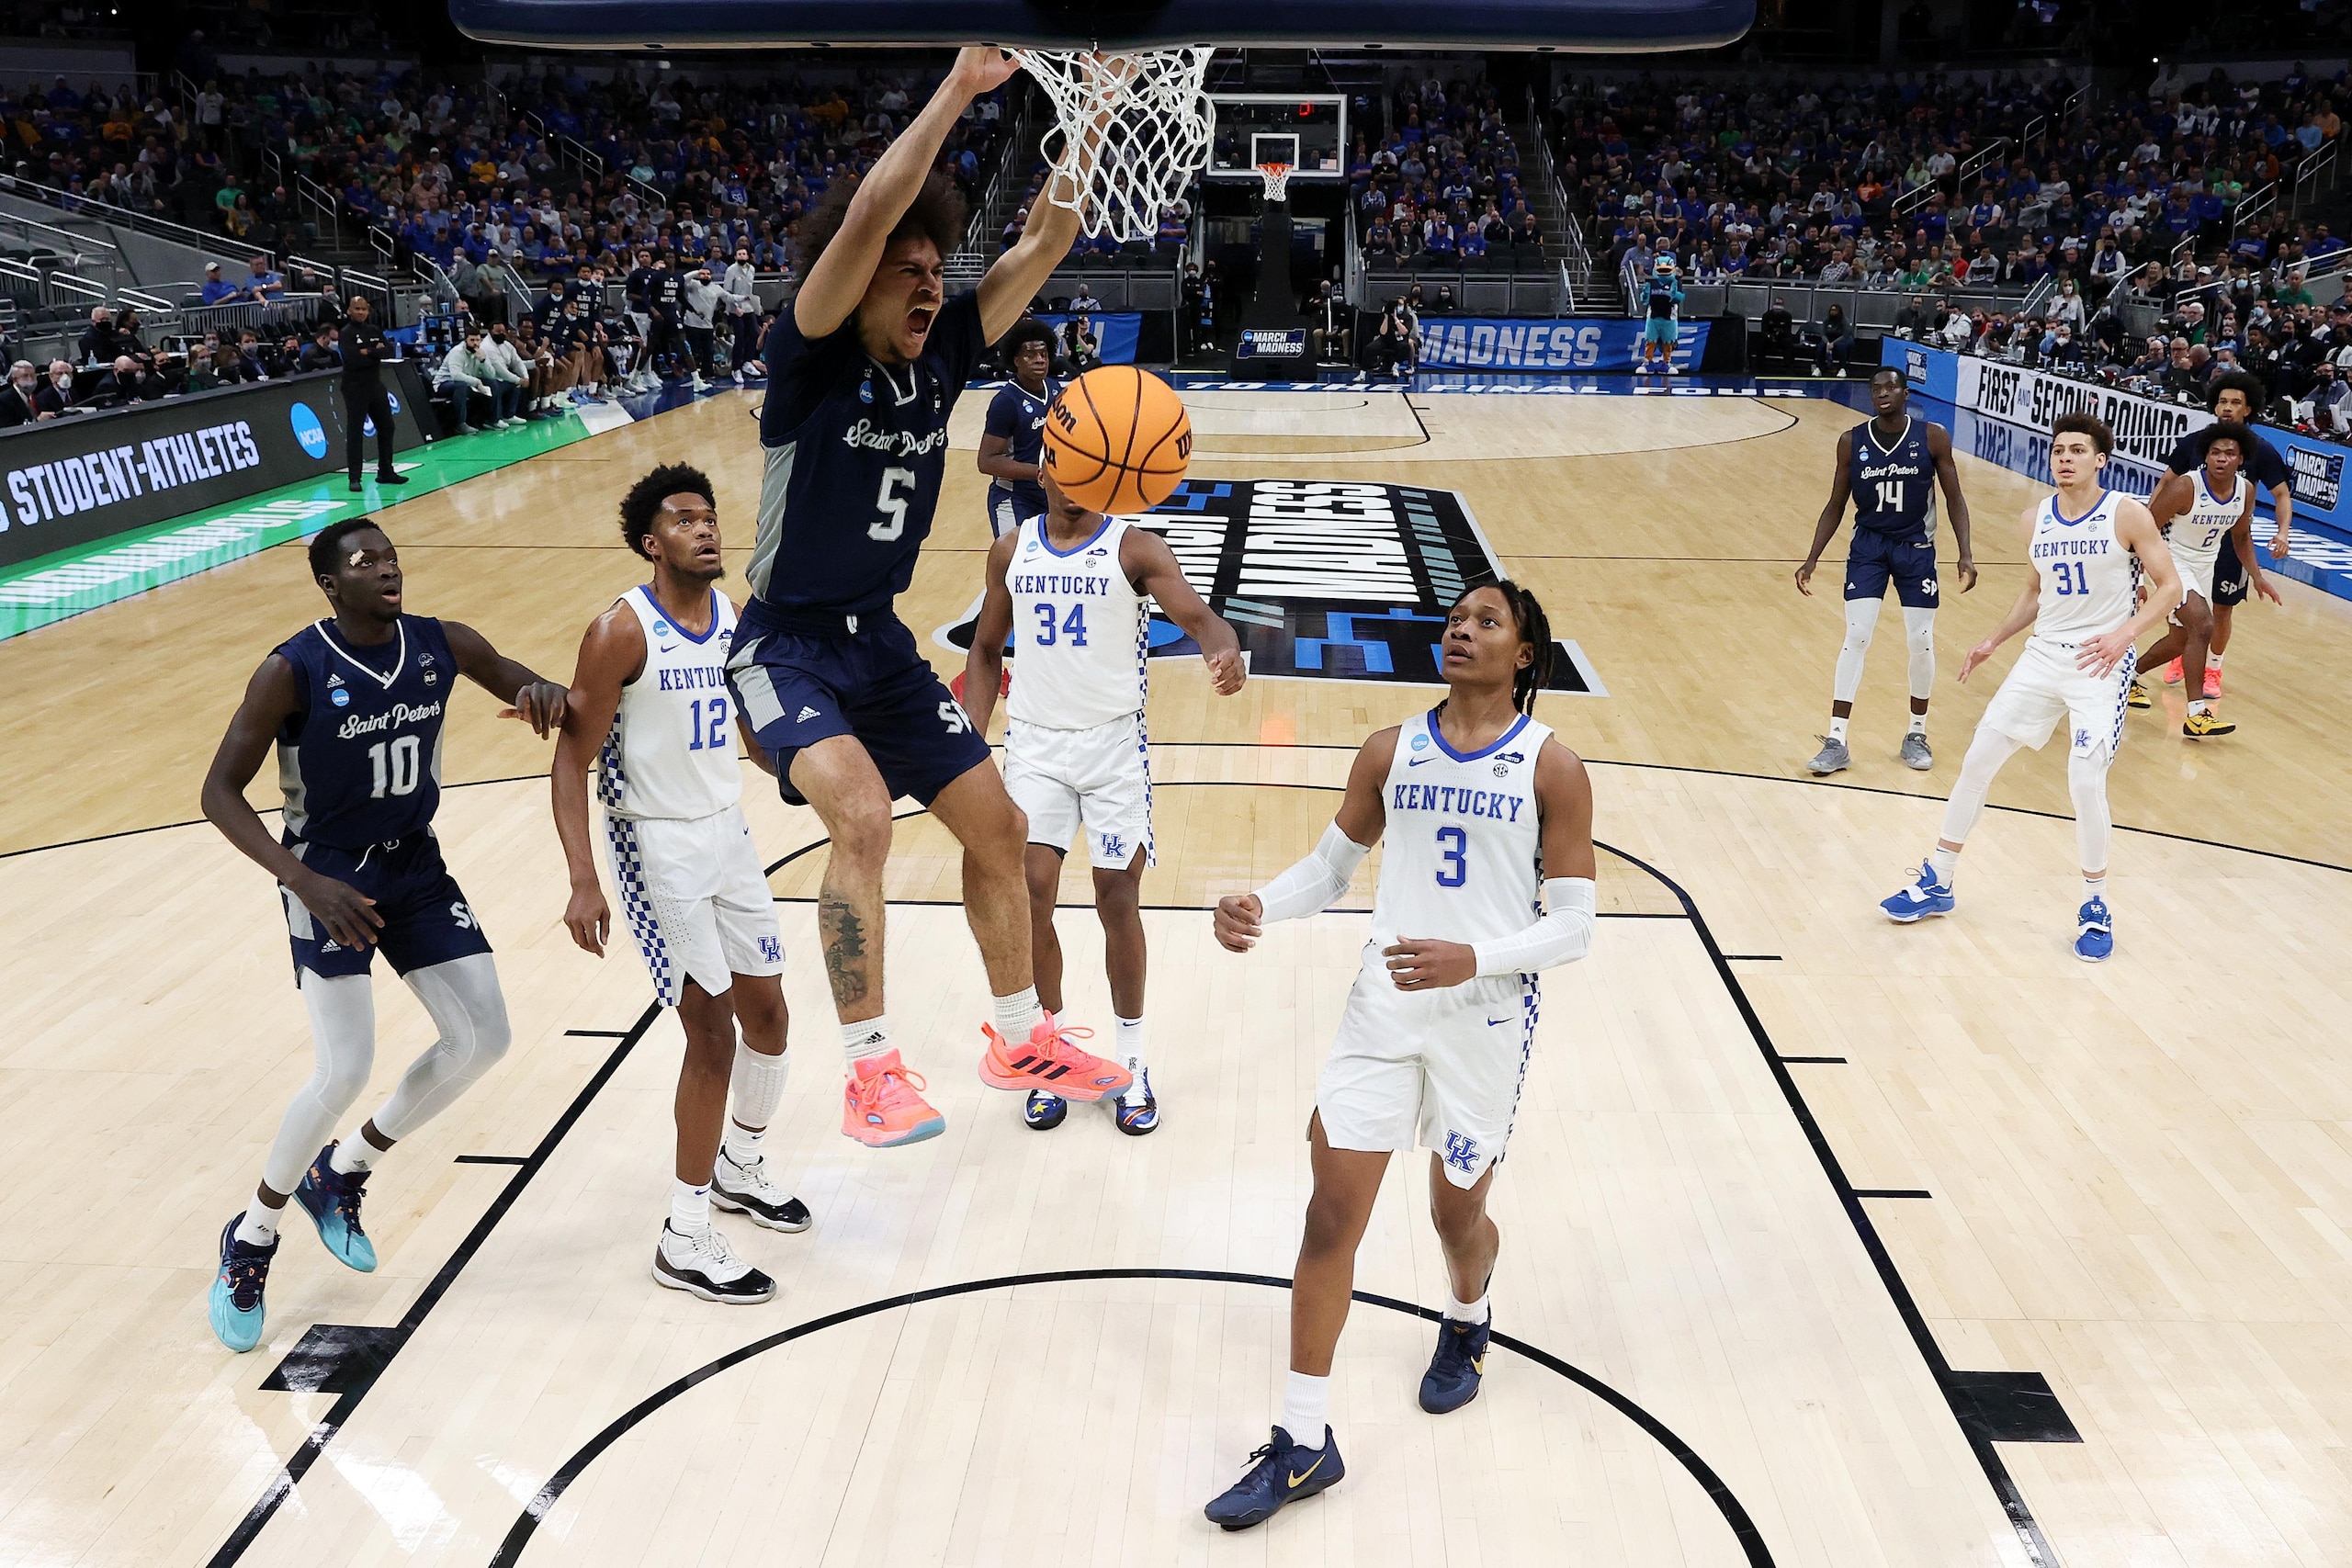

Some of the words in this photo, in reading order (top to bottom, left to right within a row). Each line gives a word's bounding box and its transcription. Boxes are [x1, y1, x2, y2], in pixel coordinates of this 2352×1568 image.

[1252, 332, 1287, 343] MARCH
[1257, 343, 1303, 353] MADNESS
[1418, 325, 1602, 367] MADNESS
[1186, 381, 1267, 391] TO
[1289, 382, 1410, 391] THE
[1427, 384, 1611, 394] FINAL
[1633, 386, 1807, 397] FOUR
[1977, 365, 2019, 416] FIRST
[2018, 388, 2031, 407] AND
[300, 427, 325, 446] NCAA
[7, 420, 260, 525] STUDENT-ATHLETES
[1860, 466, 1887, 479] Saint
[1887, 463, 1918, 477] Peter's
[2294, 451, 2327, 479] MARCH
[1875, 480, 1904, 512] 14
[2296, 473, 2339, 503] MADNESS
[866, 467, 916, 541] 5
[2191, 514, 2240, 525] KENTUCK
[1237, 481, 1421, 603] MADNESS
[2034, 540, 2109, 558] KENTUCKY
[2201, 528, 2220, 547] 2
[1015, 576, 1109, 595] KENTUCKY
[2052, 561, 2089, 595] 31
[1035, 604, 1087, 647] 34
[659, 666, 726, 691] KENTUC
[337, 711, 390, 739] Saint
[390, 700, 441, 729] Peter's
[689, 697, 728, 750] 12
[797, 711, 821, 724] adidas
[368, 735, 421, 798] 10
[1394, 784, 1523, 822] KENTUCKY
[1101, 832, 1126, 858] UK
[1436, 827, 1467, 887] 3
[758, 935, 782, 964] UK
[1444, 1129, 1480, 1174] UK
